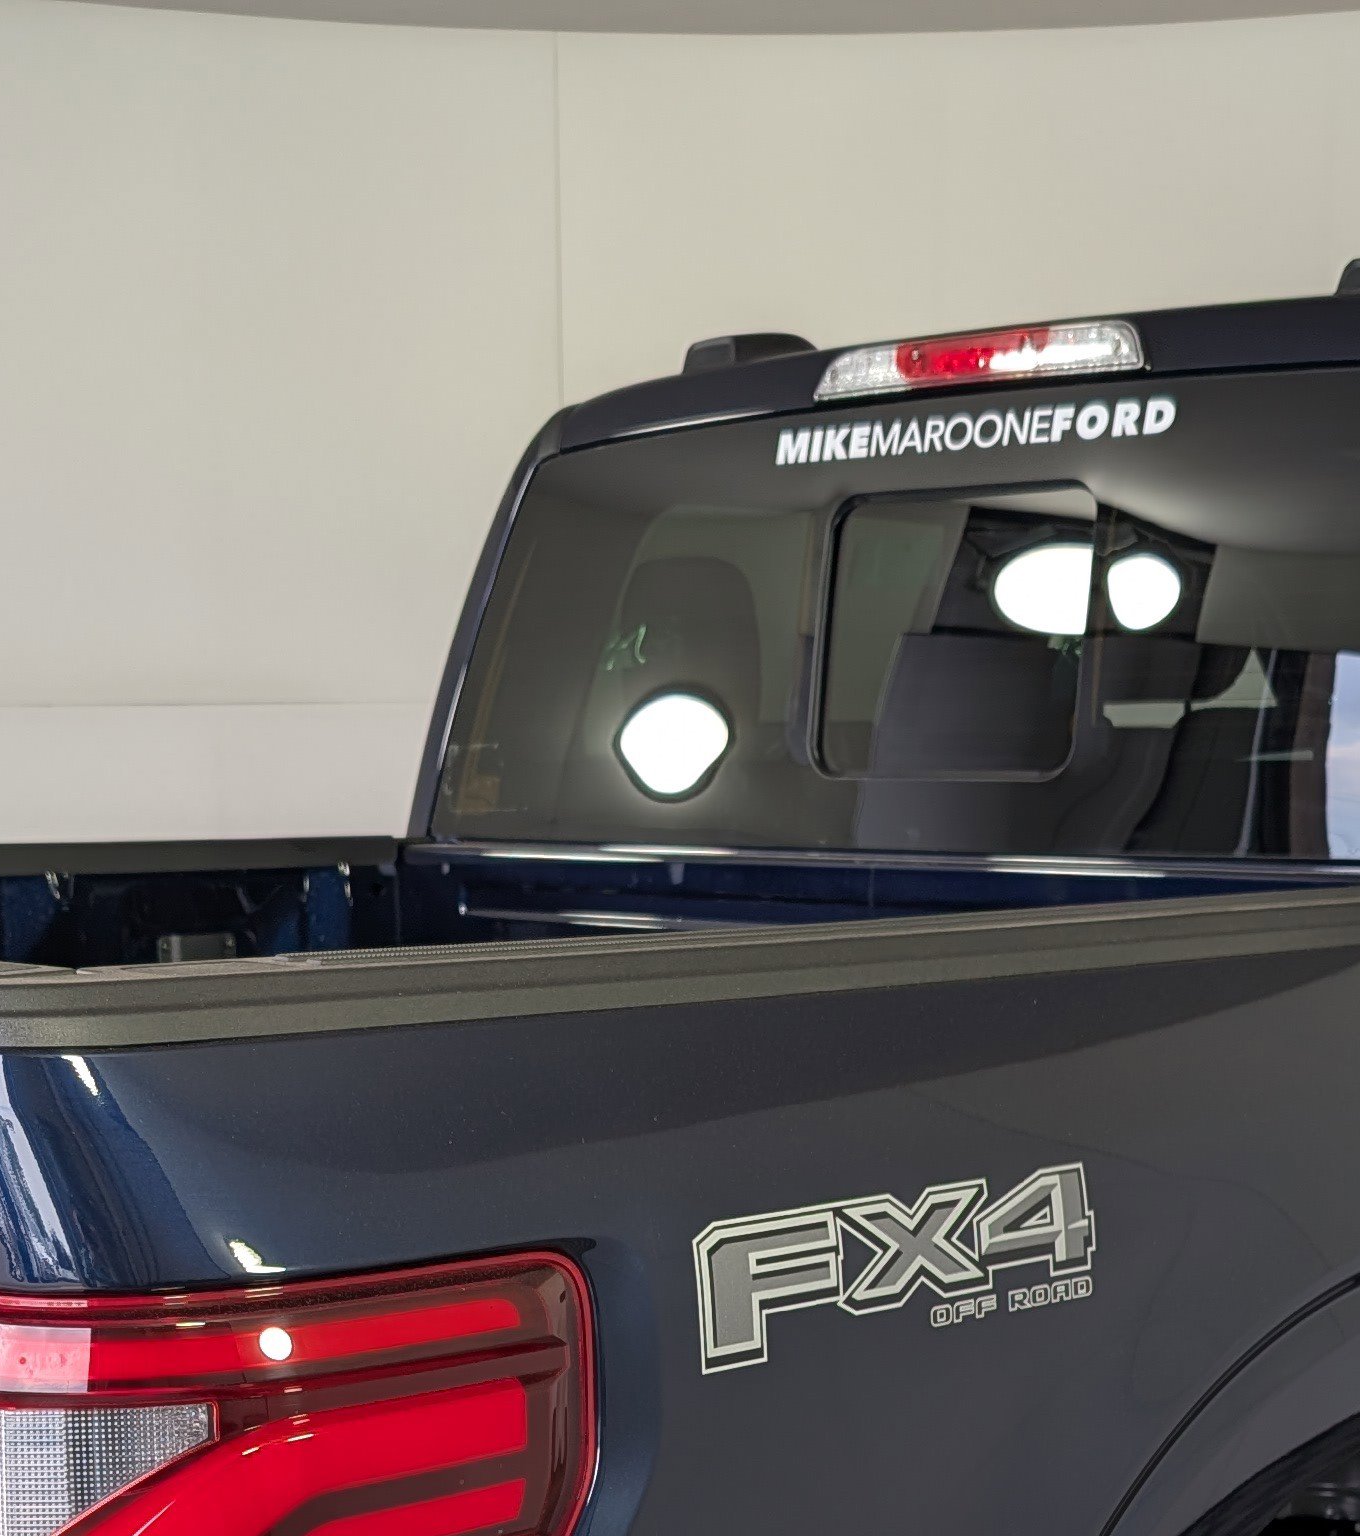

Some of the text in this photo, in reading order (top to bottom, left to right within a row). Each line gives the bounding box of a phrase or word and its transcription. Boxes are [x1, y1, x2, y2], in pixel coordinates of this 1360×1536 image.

[692, 1162, 1097, 1375] FX4
[930, 1276, 1093, 1329] OFF ROAD
